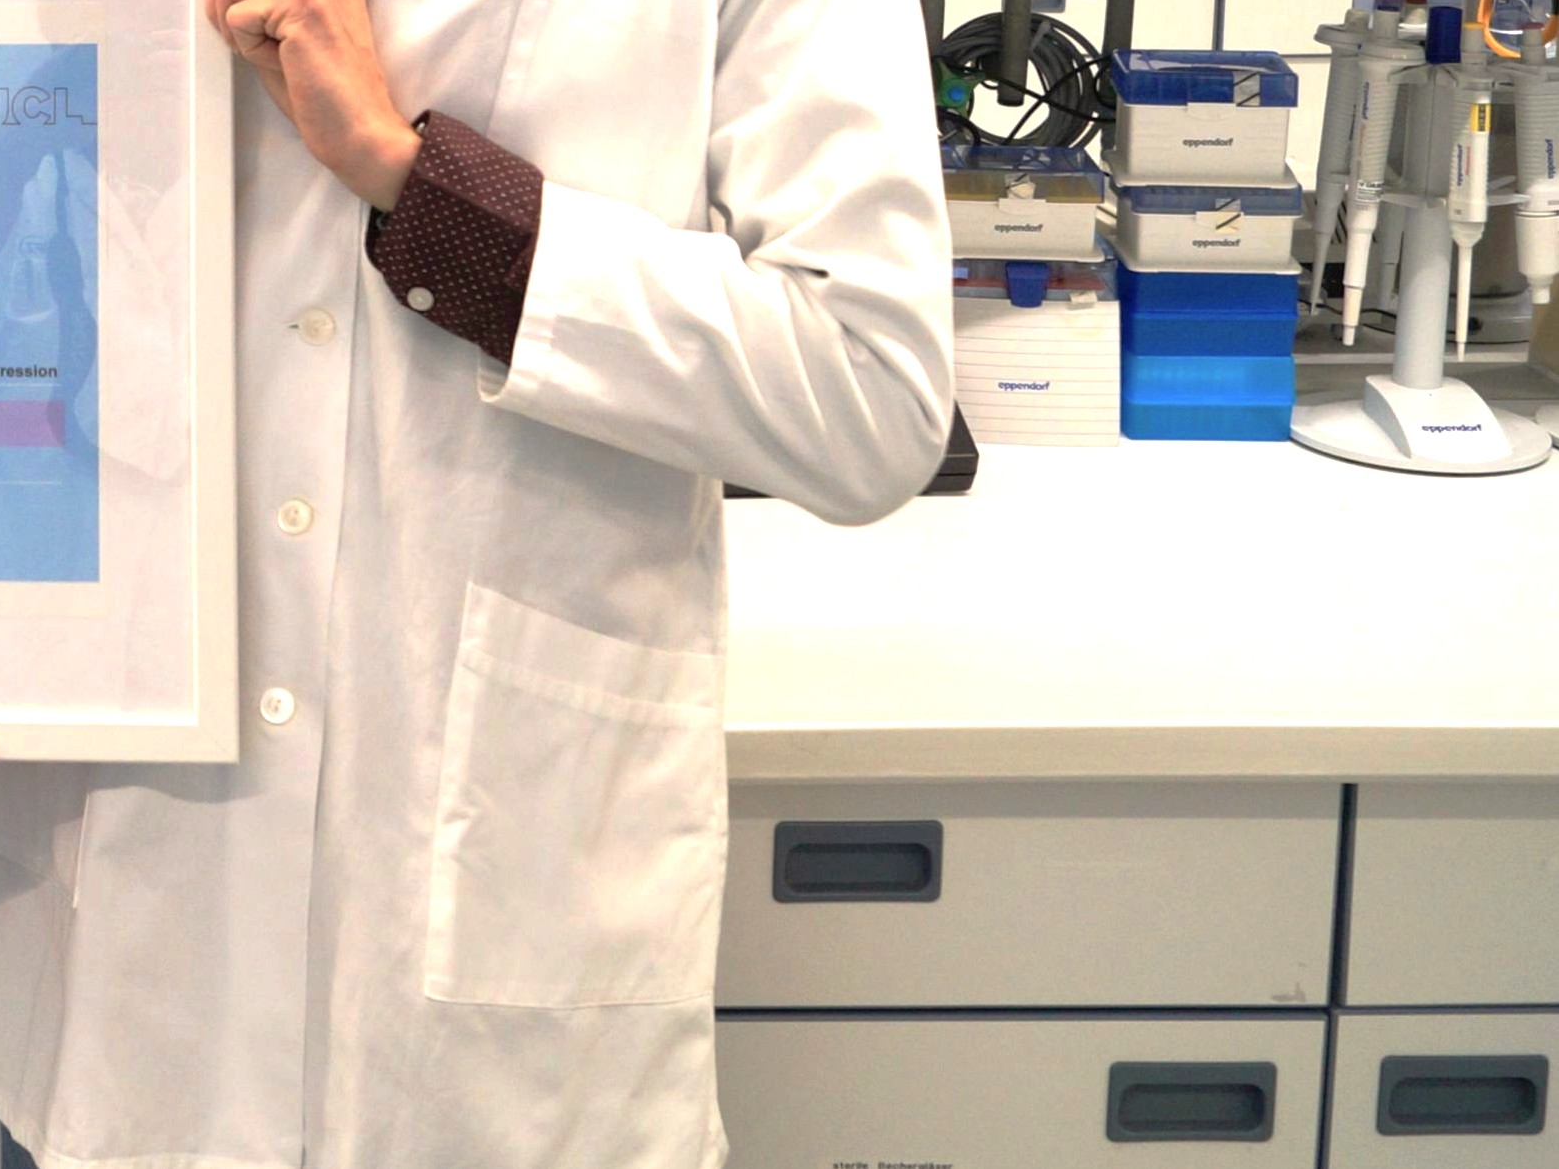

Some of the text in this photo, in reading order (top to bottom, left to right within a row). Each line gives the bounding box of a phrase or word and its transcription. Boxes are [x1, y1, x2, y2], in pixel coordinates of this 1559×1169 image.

[1182, 137, 1234, 147] eppendorf
[994, 223, 1044, 233] eppendorf
[1192, 238, 1241, 247] eppendorf
[998, 379, 1051, 392] eppendorf
[1420, 422, 1483, 434] eppendorf
